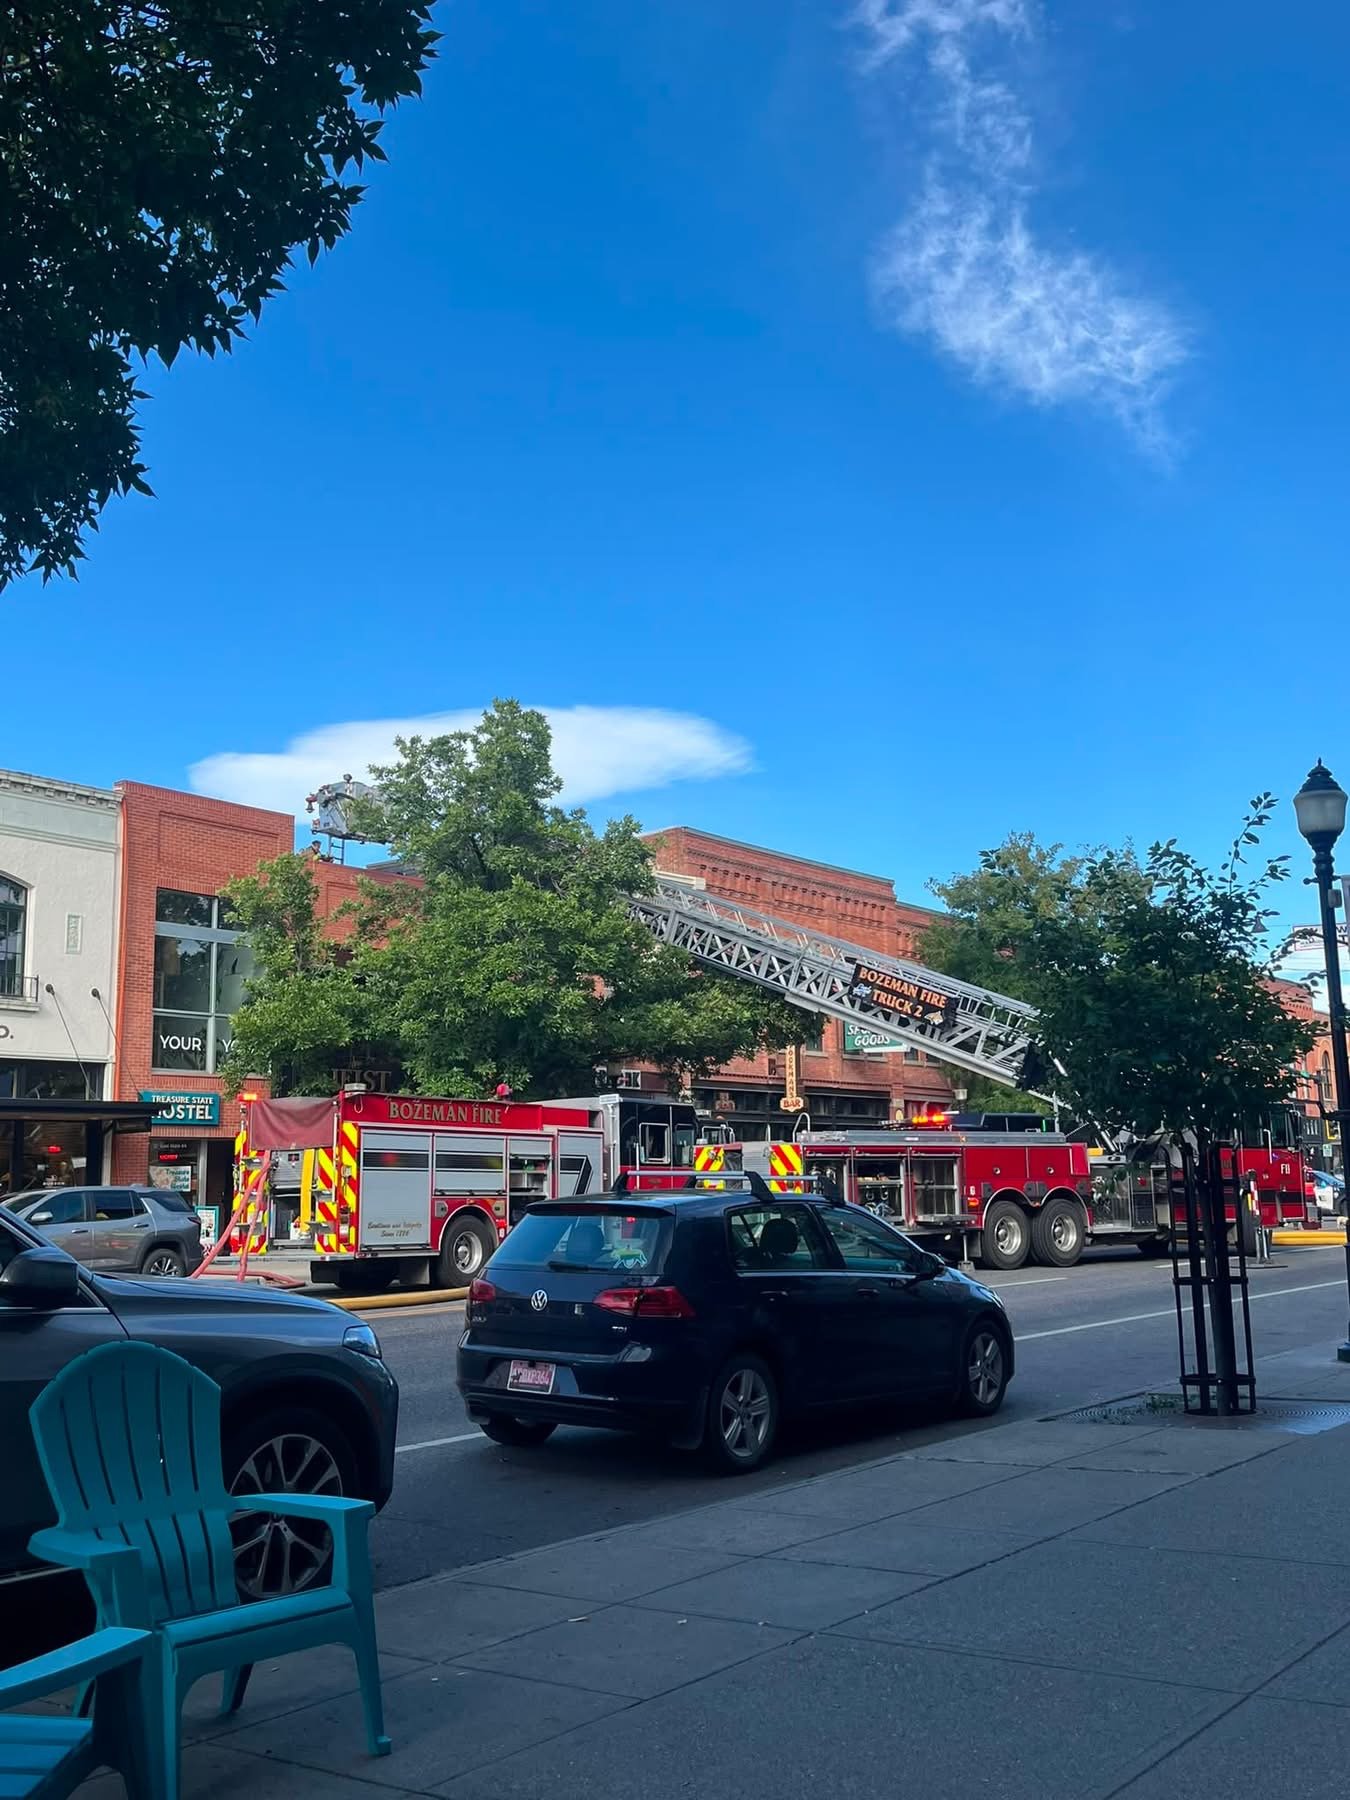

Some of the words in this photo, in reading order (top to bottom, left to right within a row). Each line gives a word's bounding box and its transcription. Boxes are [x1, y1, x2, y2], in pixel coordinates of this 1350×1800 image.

[859, 966, 919, 998] BOZEMAN
[920, 988, 948, 1009] FIRE
[872, 989, 913, 1014] TRUCK
[913, 1005, 923, 1018] 2
[160, 1035, 202, 1051] YOUR
[854, 1034, 891, 1047] GOODS
[152, 1094, 189, 1104] TREASURE
[191, 1096, 214, 1105] STATE
[783, 1100, 801, 1108] BAR
[152, 1104, 214, 1120] OSTEL
[389, 1101, 468, 1124] BOZEMAN
[472, 1106, 502, 1125] FIRE
